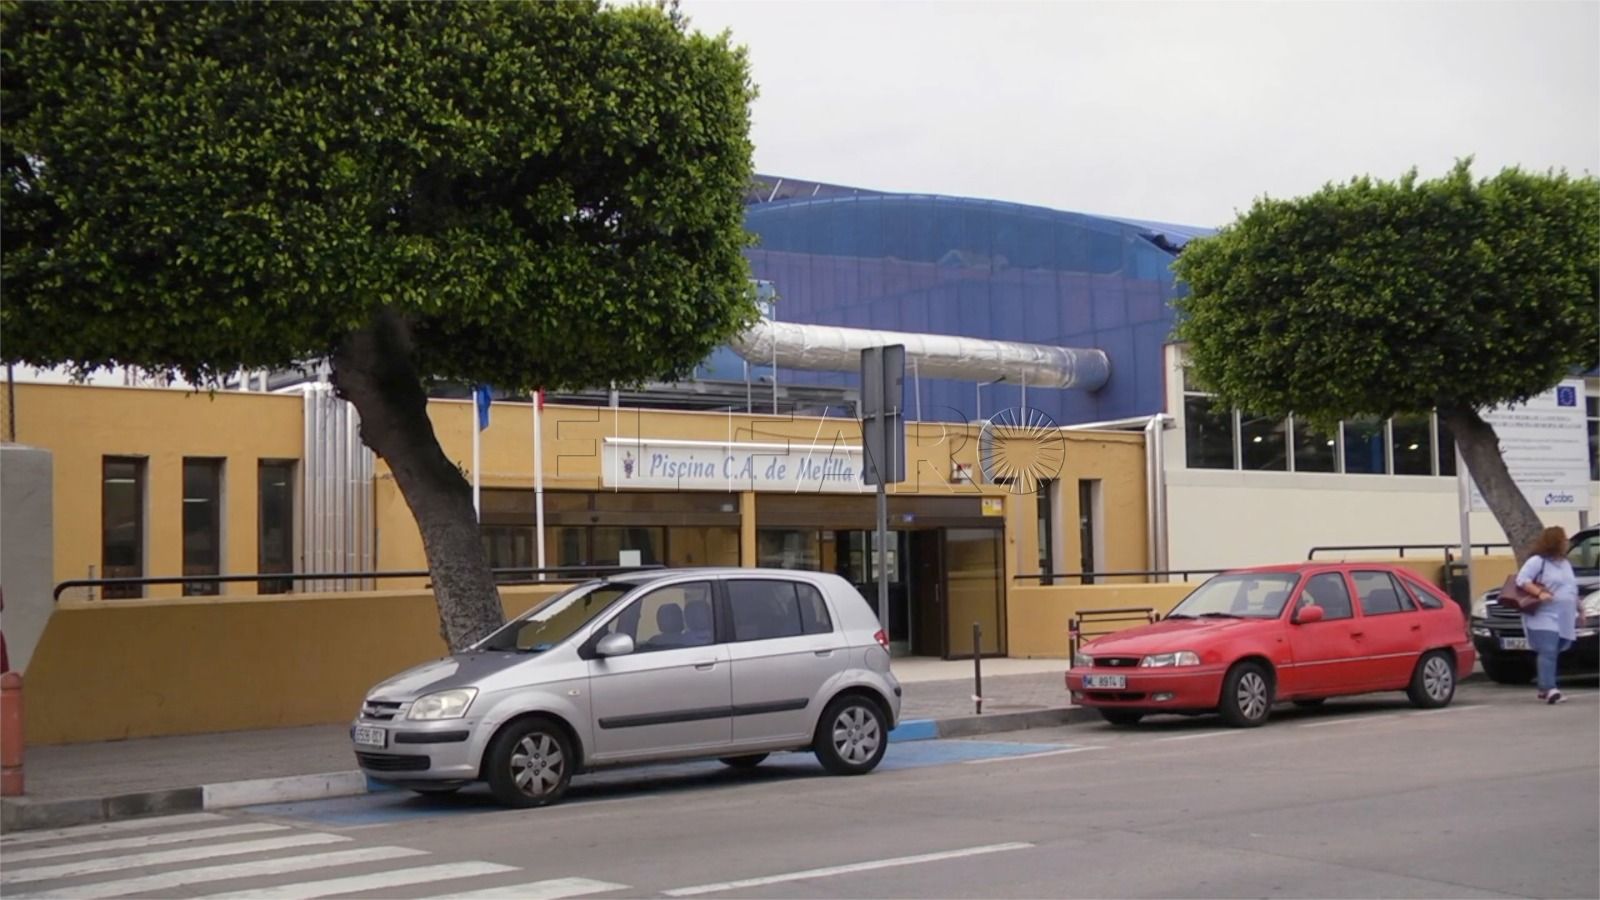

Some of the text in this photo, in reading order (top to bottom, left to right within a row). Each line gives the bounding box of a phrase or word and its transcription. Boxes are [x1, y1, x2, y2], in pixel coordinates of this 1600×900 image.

[649, 453, 716, 479] Piscina
[722, 455, 758, 480] C.A.
[765, 456, 786, 481] de
[796, 457, 852, 482] Melilla
